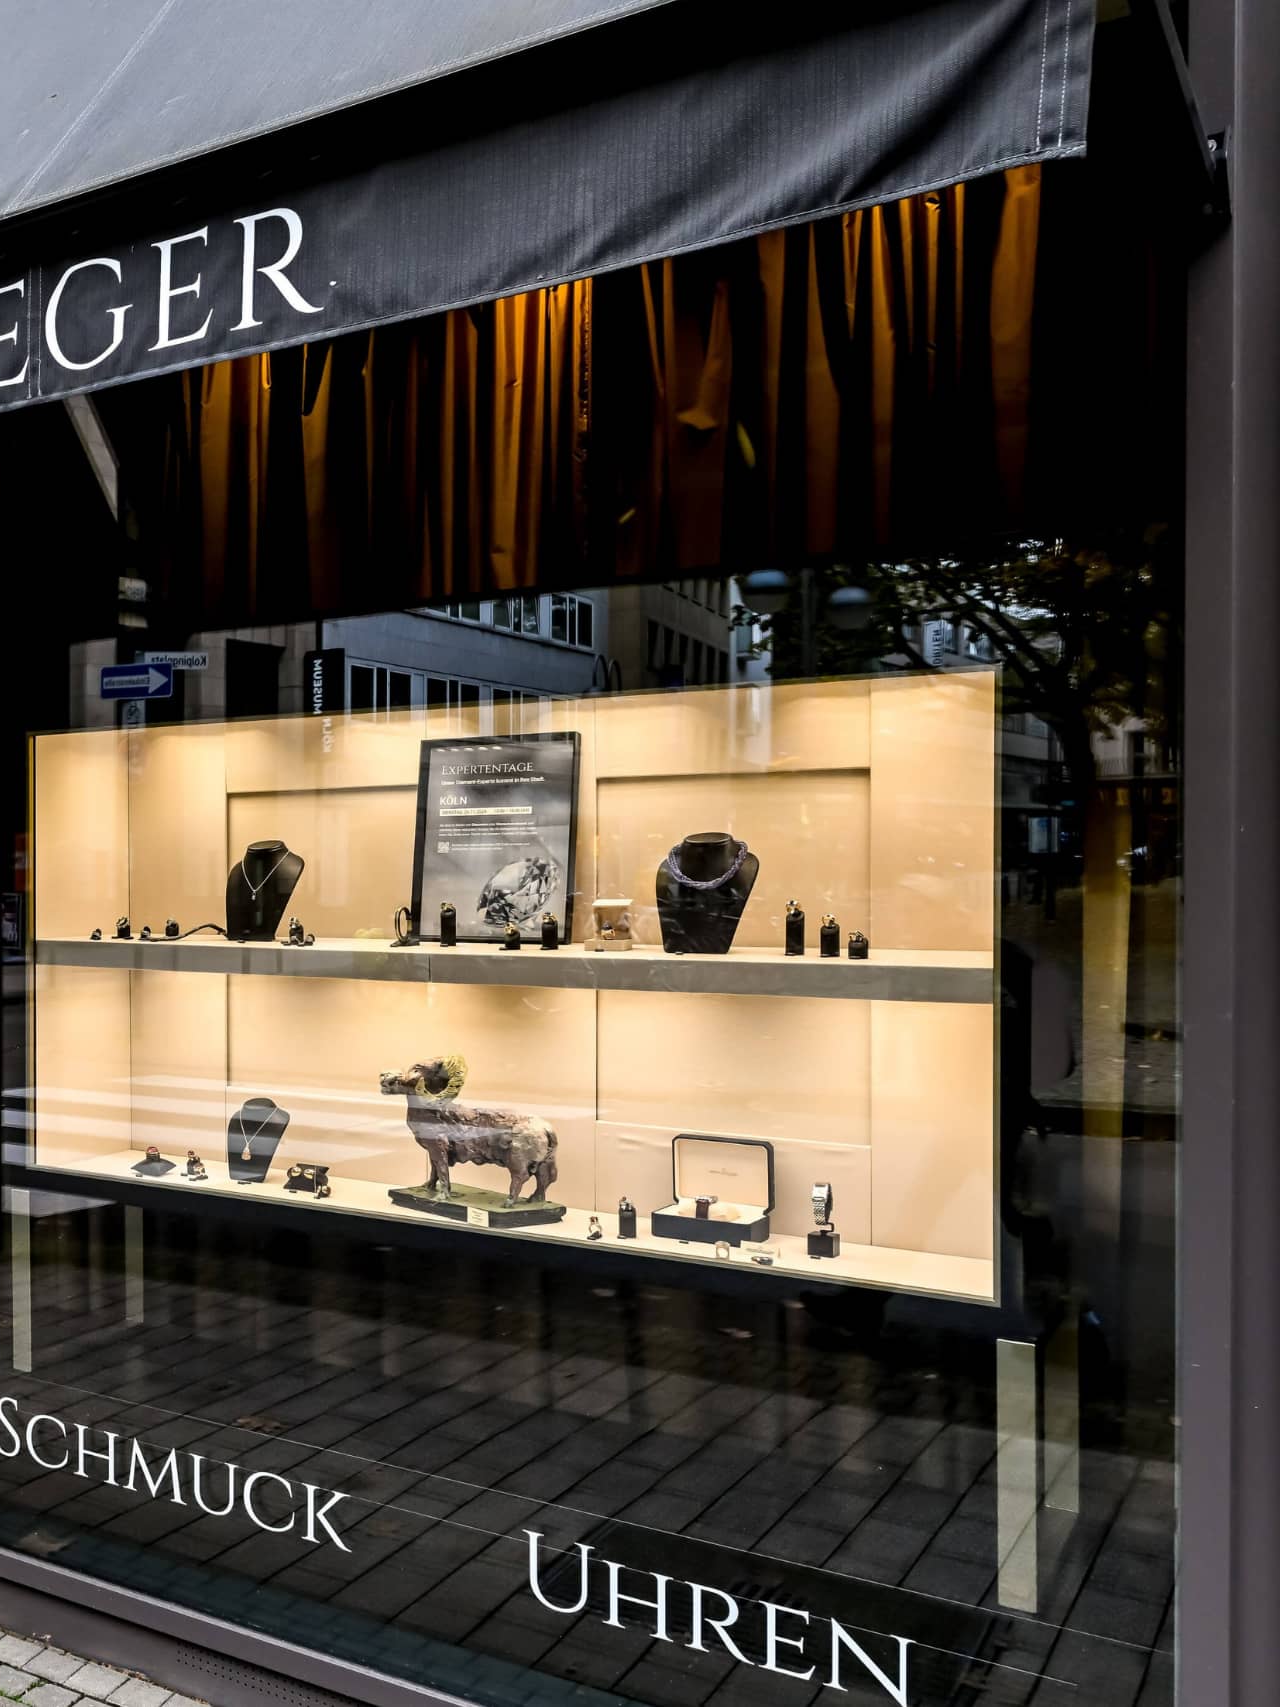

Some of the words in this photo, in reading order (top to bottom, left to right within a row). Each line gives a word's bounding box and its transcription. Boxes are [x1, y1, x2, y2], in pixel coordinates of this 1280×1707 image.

[441, 762, 535, 776] EXPERTENTAGE
[439, 794, 468, 806] KÖLN
[522, 1529, 917, 1707] UHREN
